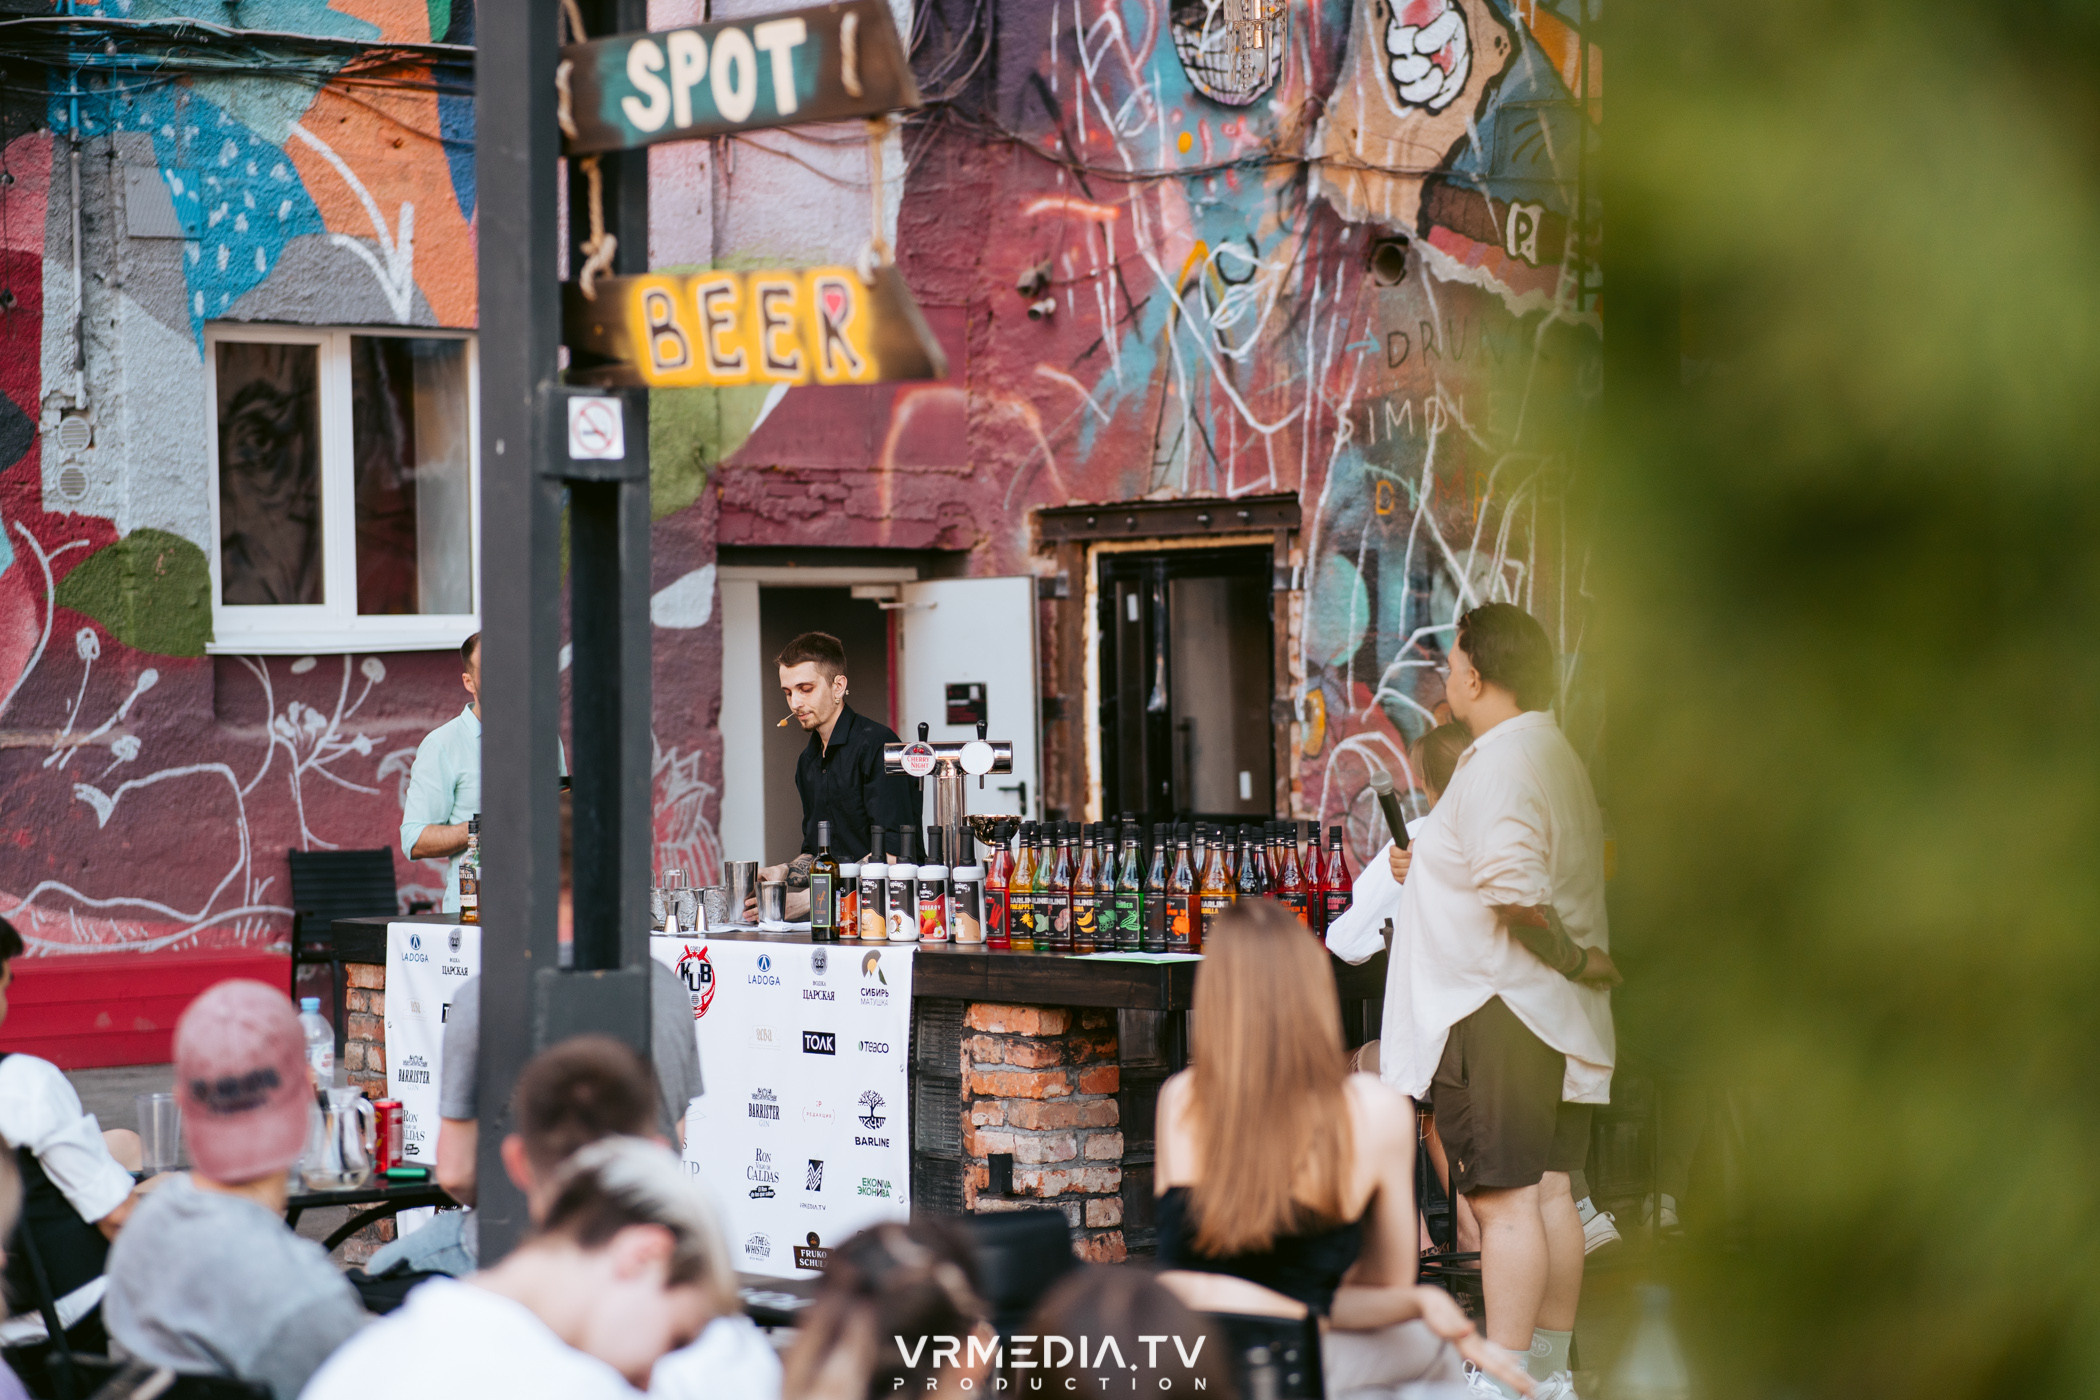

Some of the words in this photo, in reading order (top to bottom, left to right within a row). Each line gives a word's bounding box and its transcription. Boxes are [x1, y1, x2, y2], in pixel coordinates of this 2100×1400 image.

[621, 17, 807, 132] SPOT
[641, 275, 867, 375] BEER
[401, 952, 429, 963] LADOGA
[442, 965, 469, 976] ЦАРСКАЯ
[748, 974, 781, 986] LADOGA
[803, 989, 835, 1001] ЦАРСКАЯ
[860, 987, 890, 998] СИБИРЬ
[860, 997, 889, 1007] МАТУШКА
[398, 1068, 430, 1084] BARRISTER
[748, 1103, 780, 1120] BARRISTER
[855, 1136, 890, 1148] BARLINE
[747, 1165, 780, 1183] CALDAS
[862, 1177, 892, 1190] EKONIVA
[857, 1186, 891, 1198] ЭКОНИВА
[755, 1235, 765, 1246] THE
[745, 1244, 771, 1258] WHISTLER
[800, 1249, 827, 1259] FRUKO
